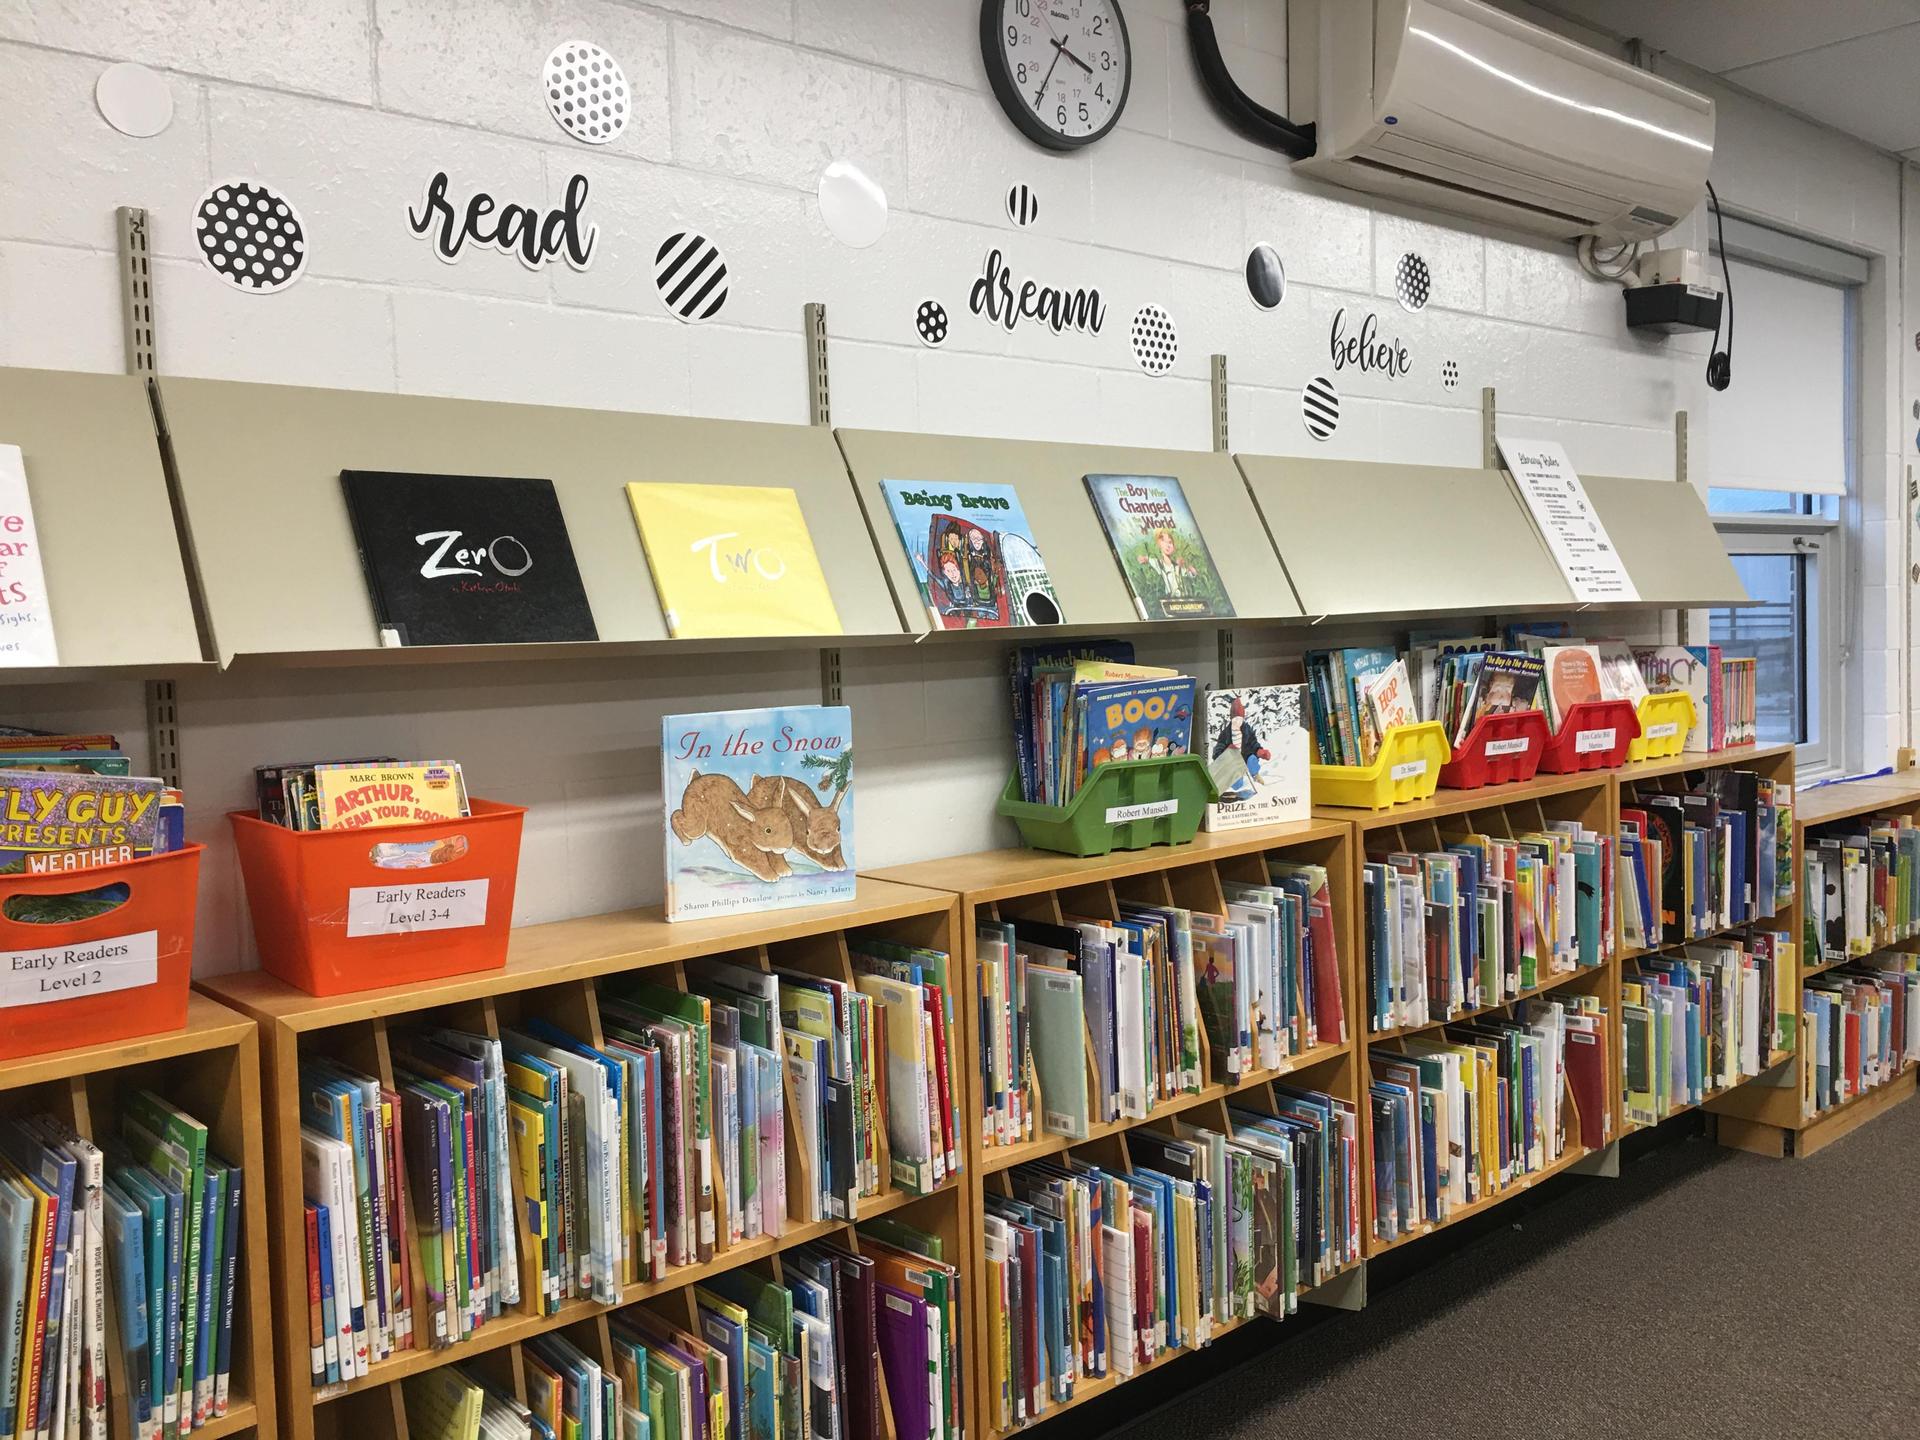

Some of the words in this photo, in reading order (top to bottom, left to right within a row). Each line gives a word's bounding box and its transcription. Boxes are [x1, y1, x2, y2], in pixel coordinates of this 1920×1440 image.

[1008, 25, 1017, 46] 9
[1082, 28, 1090, 36] 14
[1093, 16, 1102, 36] 2
[1023, 35, 1031, 44] 21
[1101, 51, 1110, 70] 3
[1018, 63, 1026, 84] 8
[1058, 92, 1065, 103] 18
[1073, 89, 1081, 98] 17
[1095, 82, 1104, 101] 4
[1057, 105, 1066, 125] 6
[1079, 102, 1088, 121] 5
[408, 172, 595, 265] read
[969, 248, 1107, 333] dream
[1331, 308, 1412, 377] believe
[900, 489, 952, 511] Being
[957, 493, 1010, 510] Brave
[1115, 487, 1128, 497] The
[1126, 483, 1148, 500] Boy
[1119, 498, 1172, 517] Changed
[1141, 515, 1176, 530] World
[1377, 677, 1398, 714] HOP
[1106, 694, 1178, 729] BOO!
[675, 731, 712, 760] In
[721, 729, 764, 757] the
[773, 726, 842, 752] Snow
[350, 774, 376, 782] MARC
[381, 772, 414, 782] BROWN
[66, 791, 156, 824] GUY
[335, 784, 420, 817] ARTHUR,
[1216, 801, 1247, 814] PRIZE
[1271, 796, 1298, 807] SNOW
[374, 806, 409, 819] YOUR
[1117, 807, 1140, 819] Robert
[1142, 804, 1168, 816] Munsch
[29, 846, 132, 875] WEATHER
[376, 889, 412, 904] Early
[416, 887, 466, 900] Readers
[684, 902, 709, 911] Sharon
[711, 898, 740, 908] Phillips
[806, 889, 828, 897] Nancy
[389, 909, 425, 924] Level
[429, 908, 450, 920] 3-4
[12, 954, 58, 970] Early
[64, 944, 128, 965] Readers
[40, 972, 86, 992] Level
[92, 970, 102, 984] 2
[431, 1167, 440, 1224] CRICKWING
[368, 1264, 377, 1296] LIBRARY
[95, 1299, 103, 1332] ENGINEER
